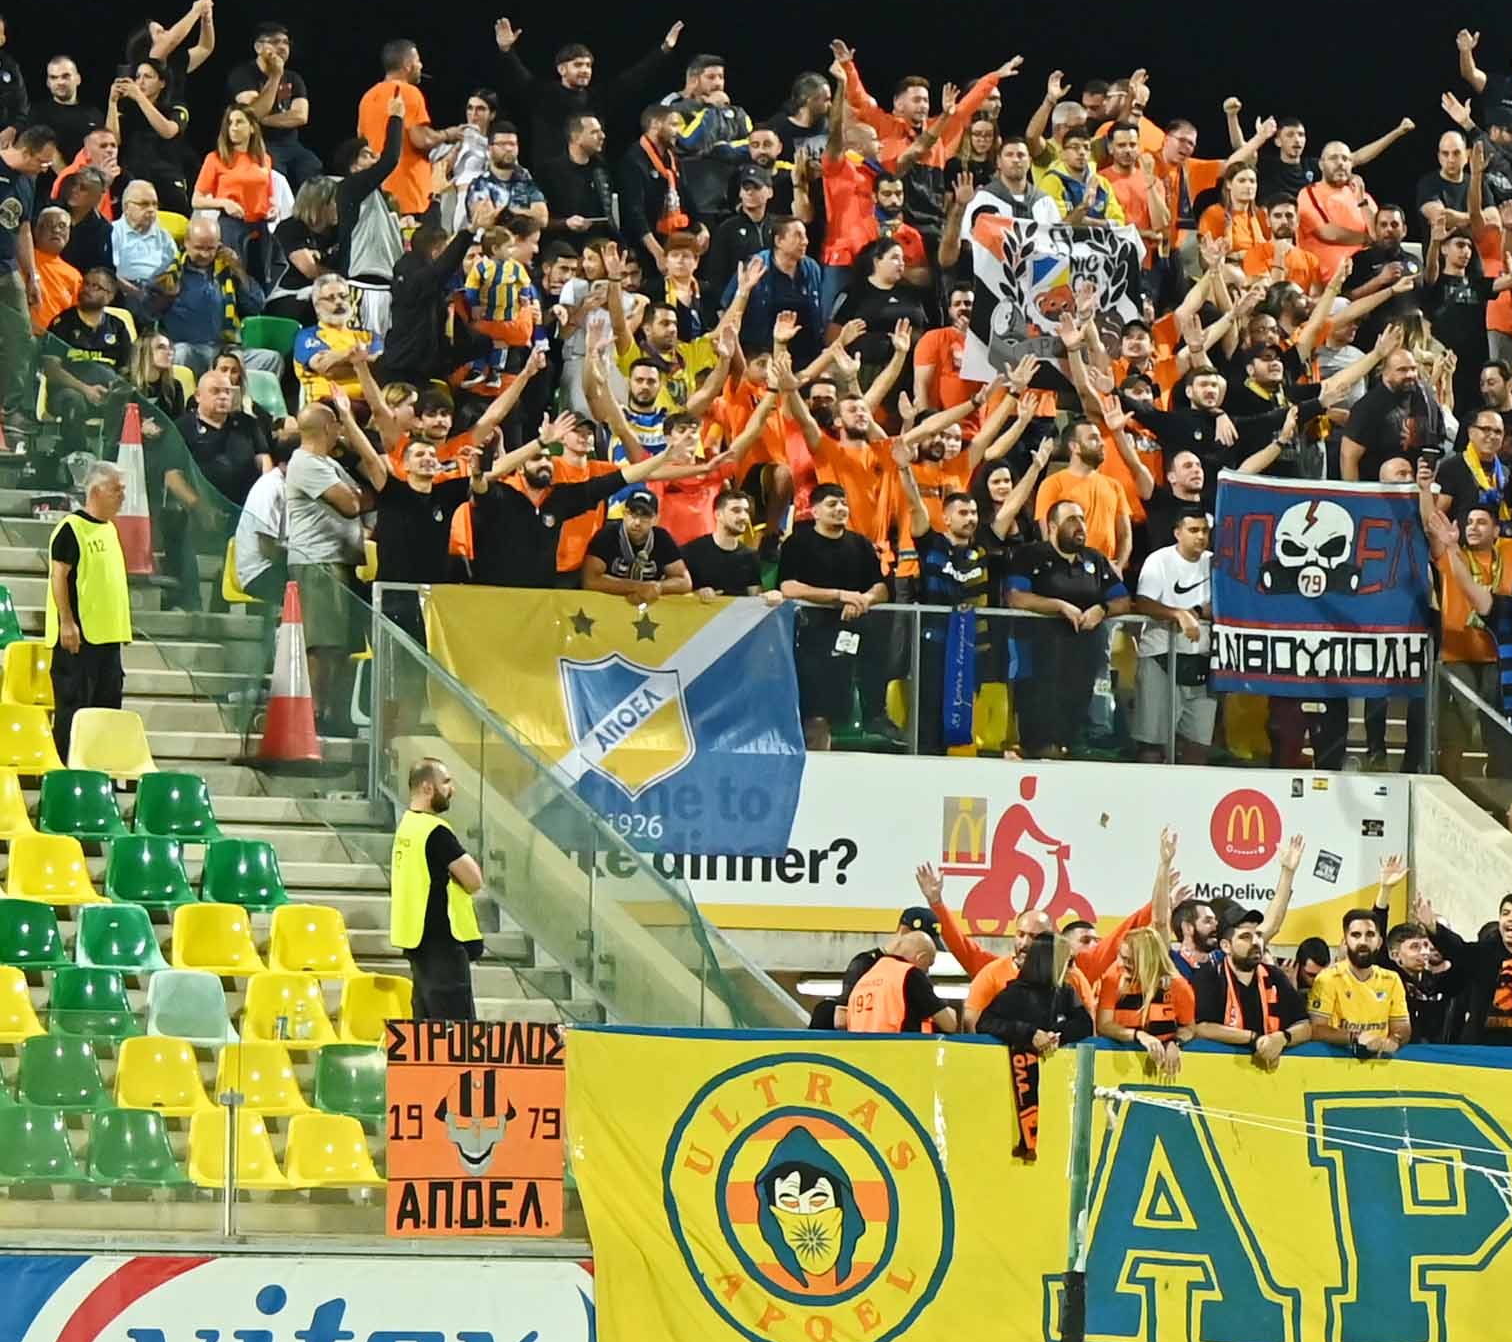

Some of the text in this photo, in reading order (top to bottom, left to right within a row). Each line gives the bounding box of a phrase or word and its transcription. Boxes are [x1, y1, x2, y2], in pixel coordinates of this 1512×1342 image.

[1300, 574, 1322, 594] 79
[593, 687, 664, 755] ΑΠΟΕΛ
[388, 1104, 562, 1142] 19 79
[683, 1069, 917, 1177] ULTRAS
